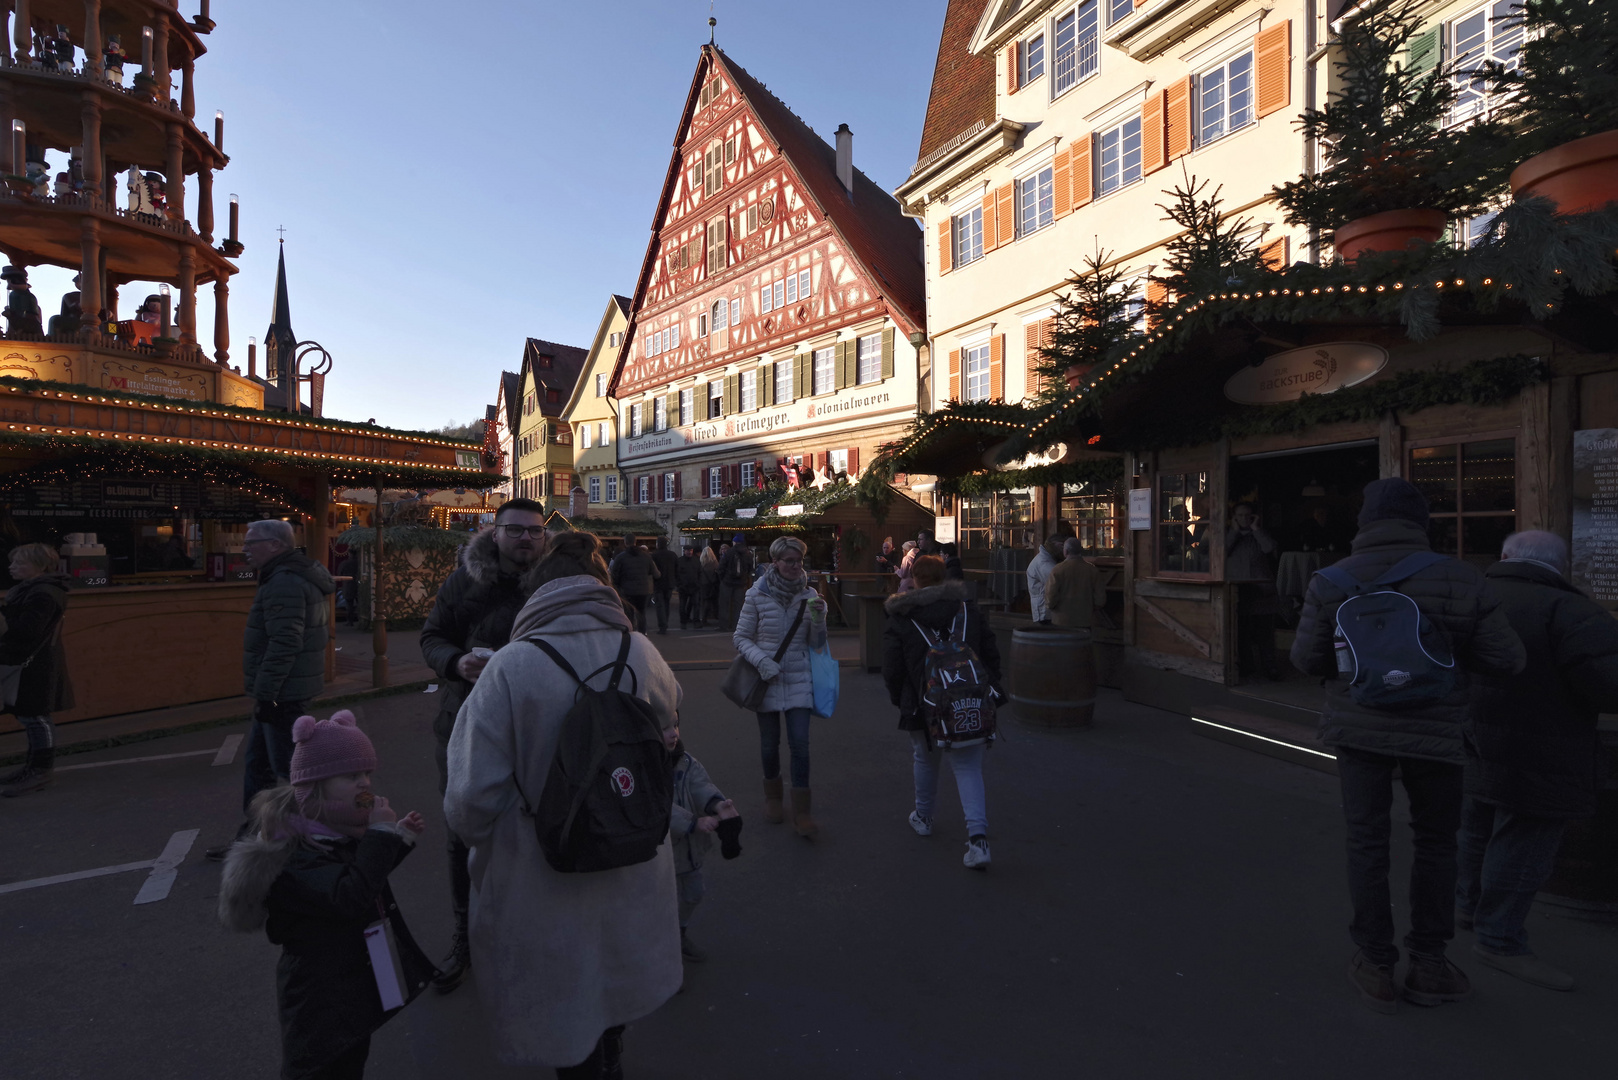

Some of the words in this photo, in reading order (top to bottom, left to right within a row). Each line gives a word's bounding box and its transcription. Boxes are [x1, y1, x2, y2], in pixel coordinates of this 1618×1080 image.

[144, 374, 180, 386] Esslinger
[106, 485, 150, 497] GLÜHWEIN
[951, 697, 982, 712] JORDAN
[954, 708, 982, 733] 23
